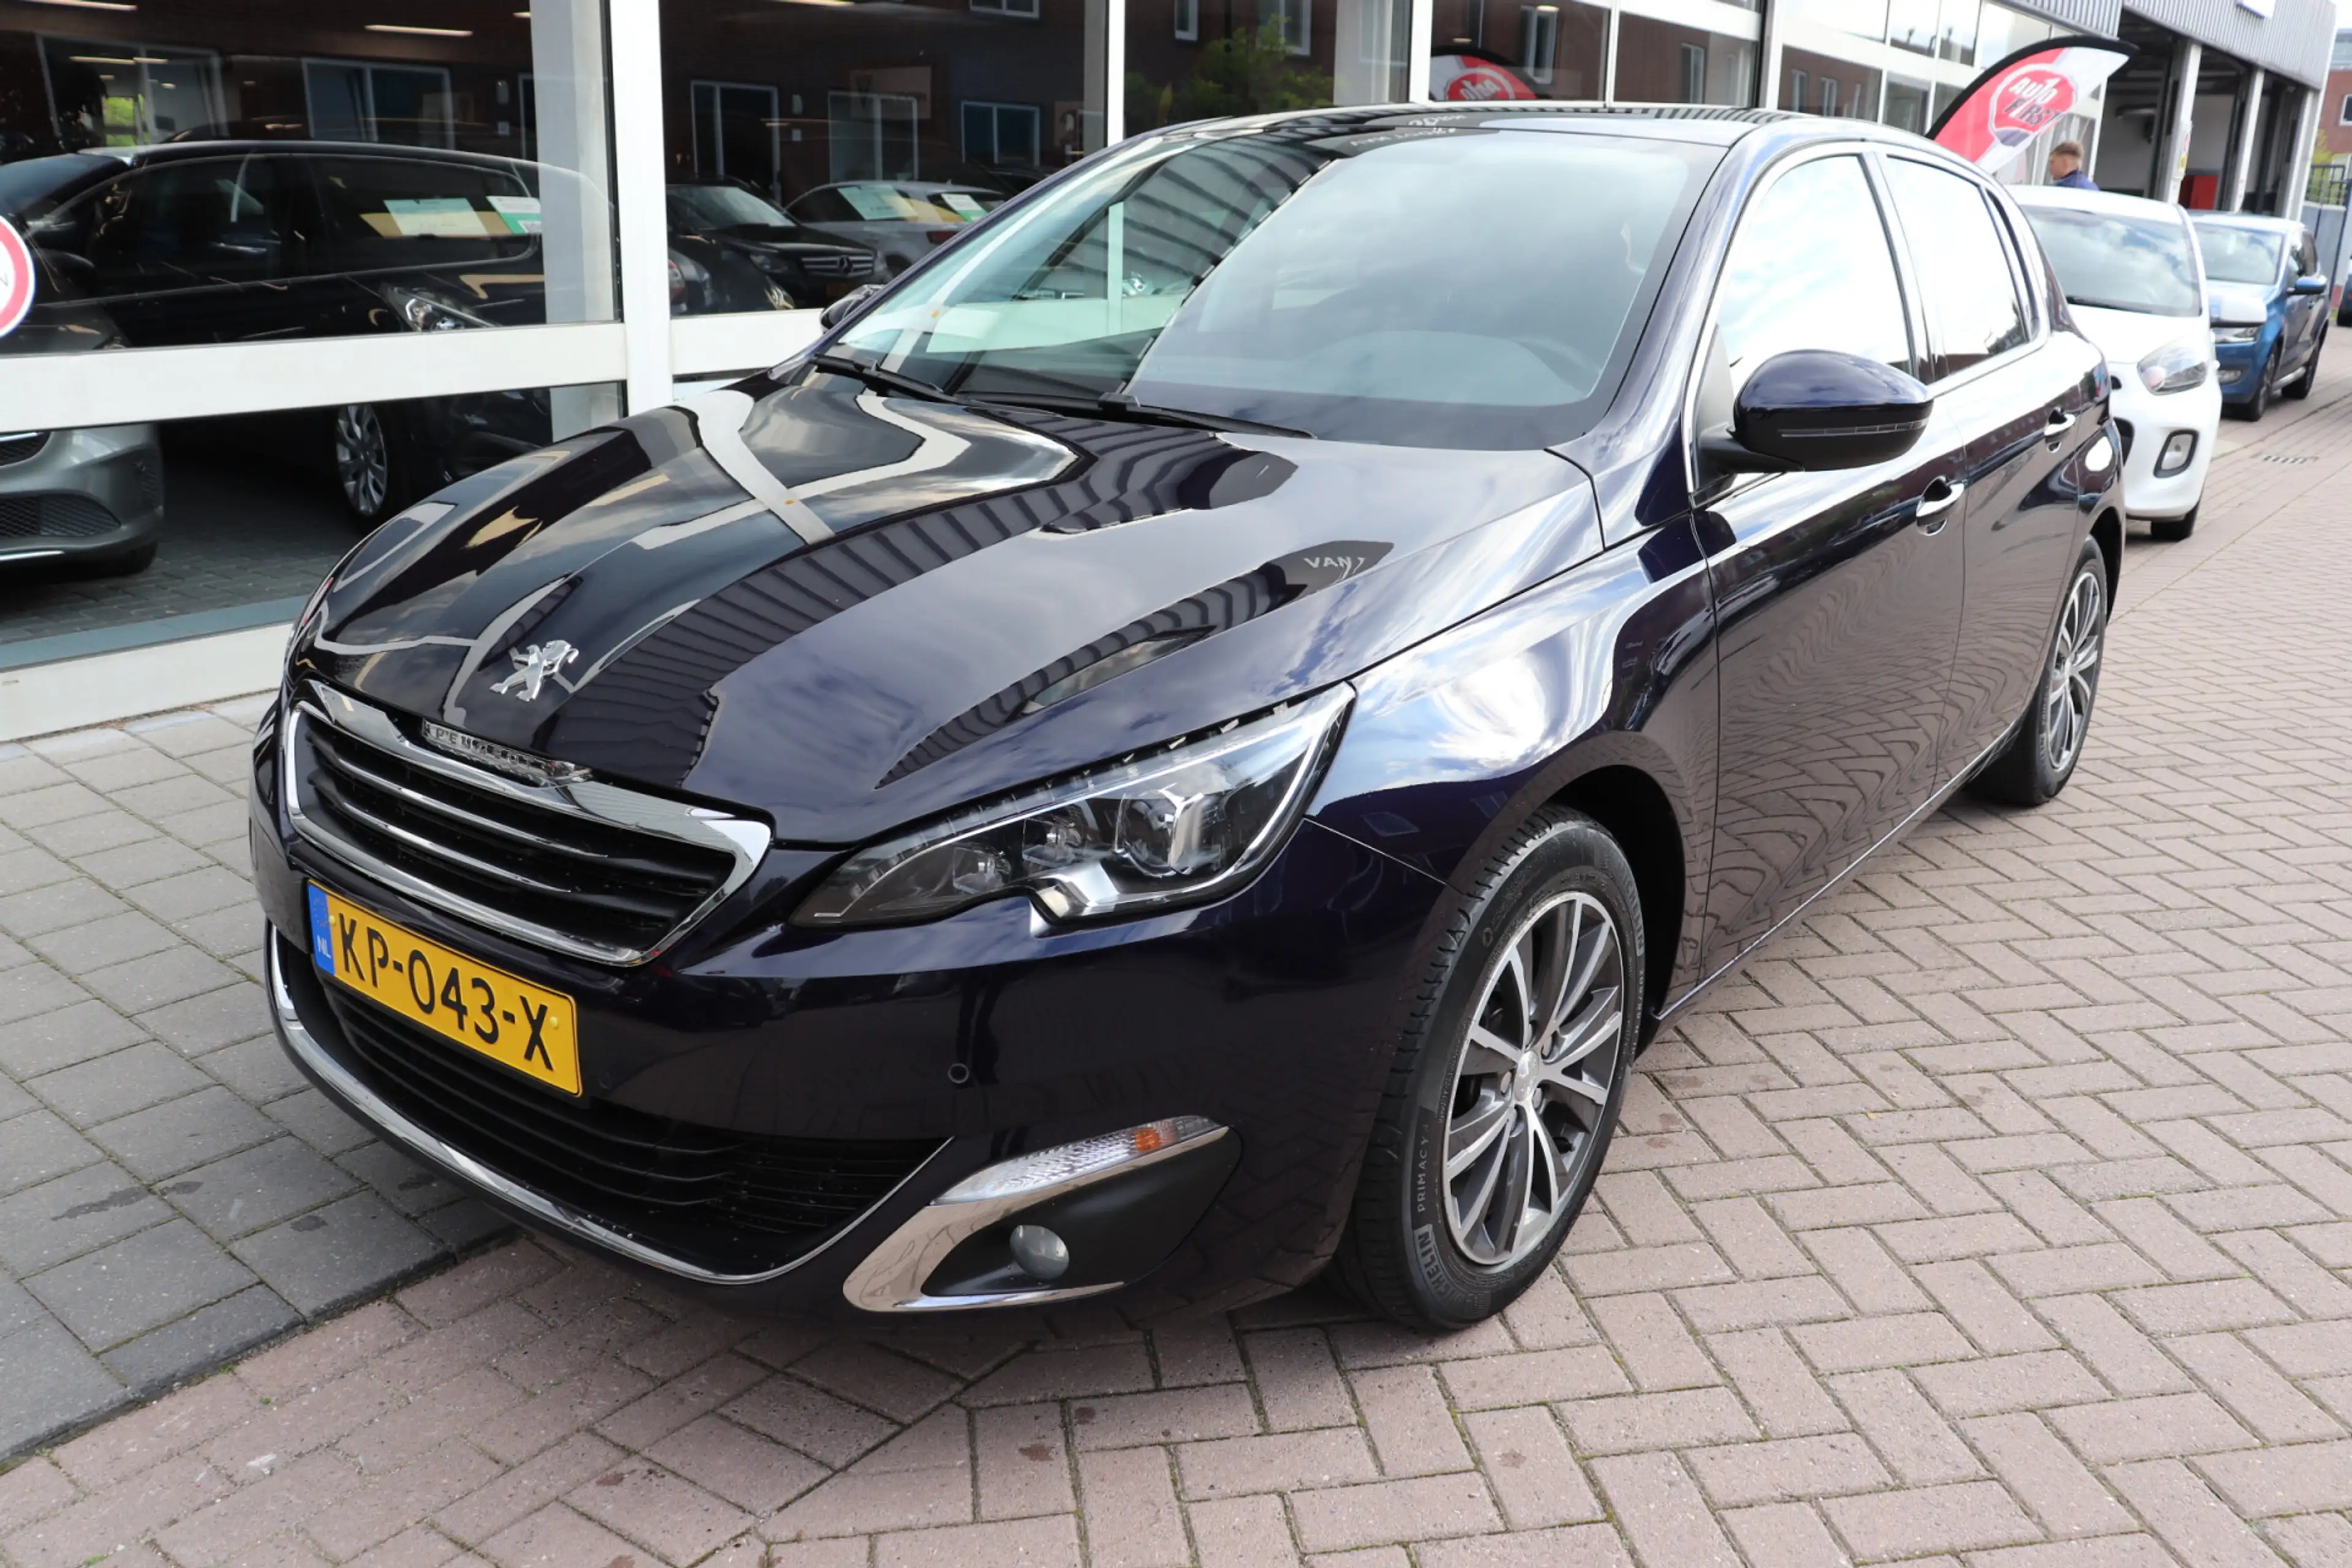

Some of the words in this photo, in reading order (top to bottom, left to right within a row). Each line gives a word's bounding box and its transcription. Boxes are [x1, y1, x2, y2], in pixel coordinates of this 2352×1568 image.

[2008, 77, 2062, 105] AUTO
[317, 935, 331, 959] NL
[339, 913, 554, 1071] KP-043-X
[1417, 1135, 1430, 1213] PRIMACY
